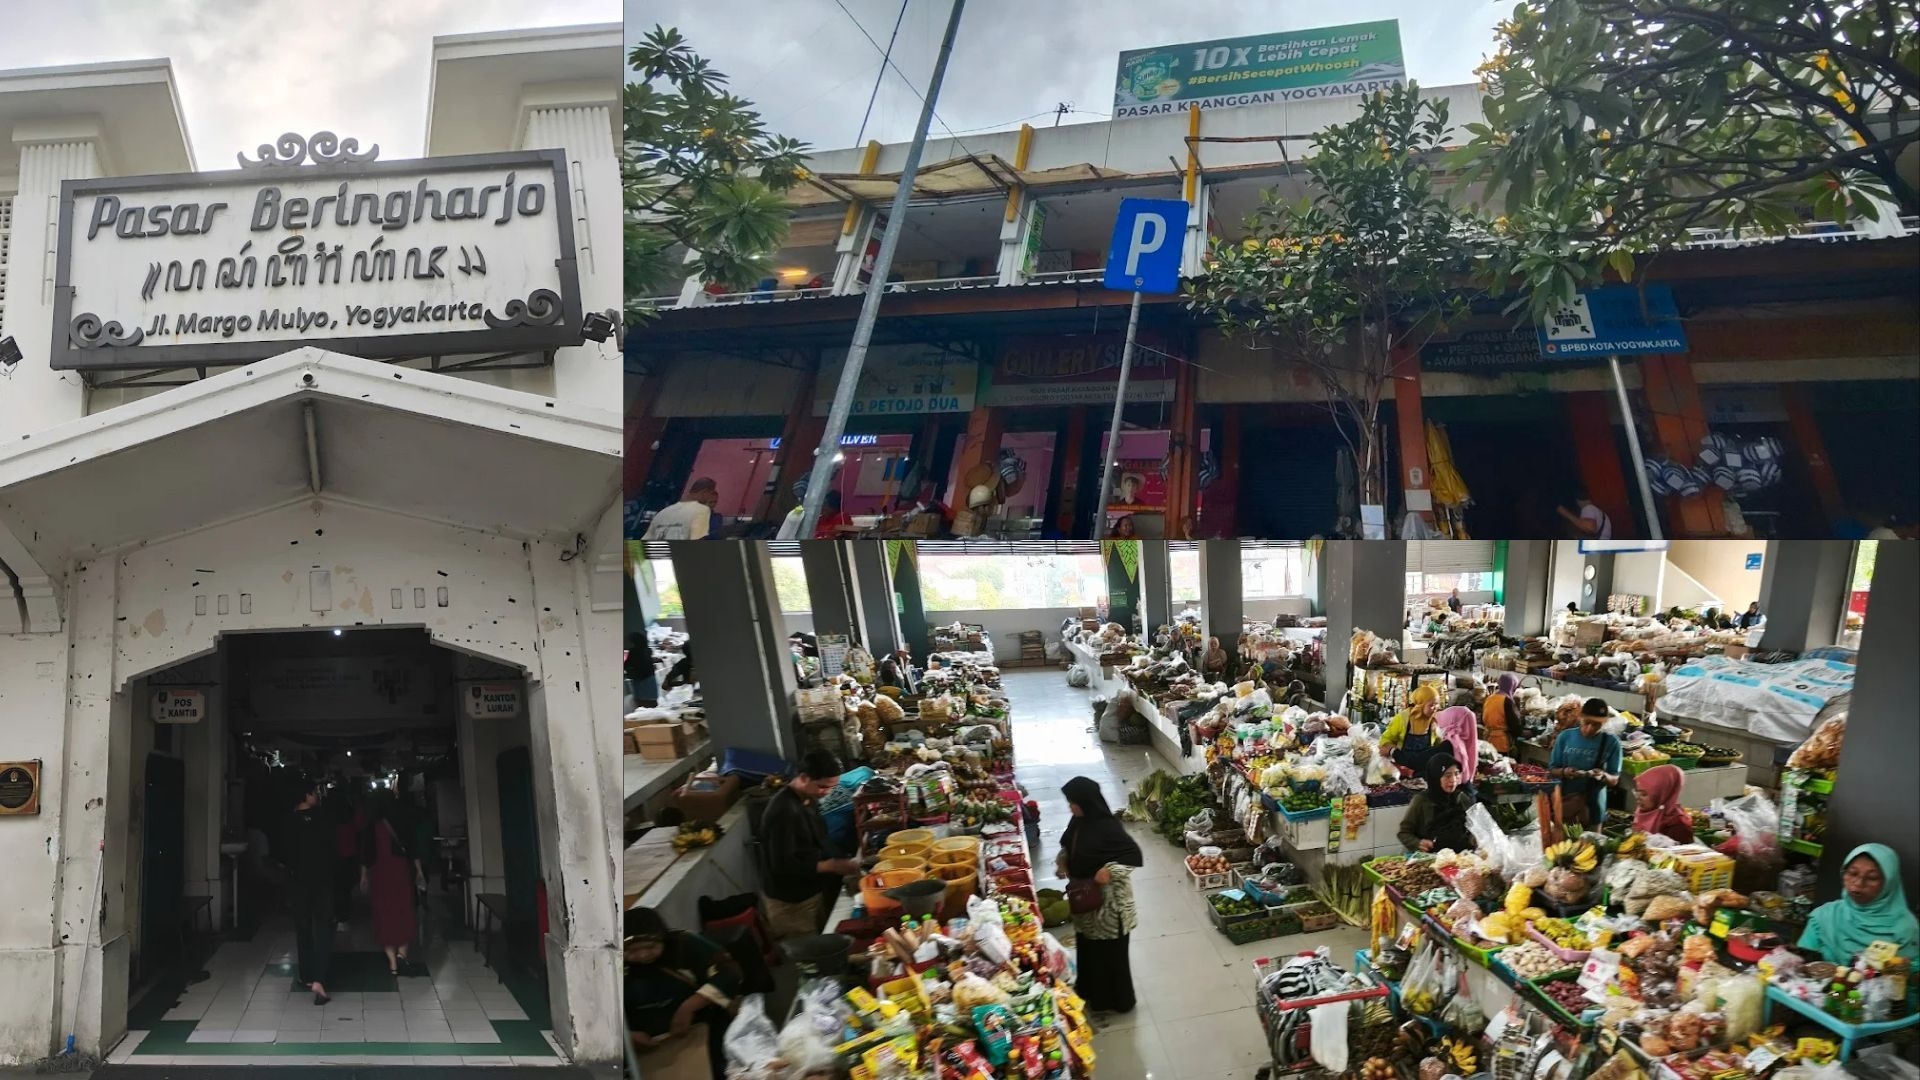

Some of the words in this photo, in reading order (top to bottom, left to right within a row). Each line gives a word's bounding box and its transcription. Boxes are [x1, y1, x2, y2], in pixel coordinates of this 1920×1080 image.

[1258, 37, 1327, 53] Bersihkan
[1330, 31, 1377, 45] Lemak
[1258, 49, 1303, 63] Lebih
[1308, 43, 1358, 59] Cepat
[1188, 58, 1361, 86] #BersihSecepatWhoosh
[1117, 103, 1172, 118] PASAR
[87, 194, 228, 240] Pasar
[251, 171, 545, 232] Beringharjo
[1125, 212, 1167, 276] P
[146, 317, 170, 337] Jl.
[176, 309, 252, 338] Margo
[258, 306, 337, 332] Mulyo,
[345, 300, 483, 329] Yogyakarta
[1561, 342, 1588, 353] BPBD
[1590, 341, 1614, 352] KOTA
[1614, 339, 1681, 351] YOGYAKARTA
[1003, 344, 1099, 376] GALLERY
[1104, 344, 1166, 368] SIVER
[1434, 356, 1467, 367] AYAM
[869, 398, 924, 412] PETOJO
[928, 396, 959, 410] DUA
[840, 434, 877, 445] ILVER
[174, 698, 193, 707] POS
